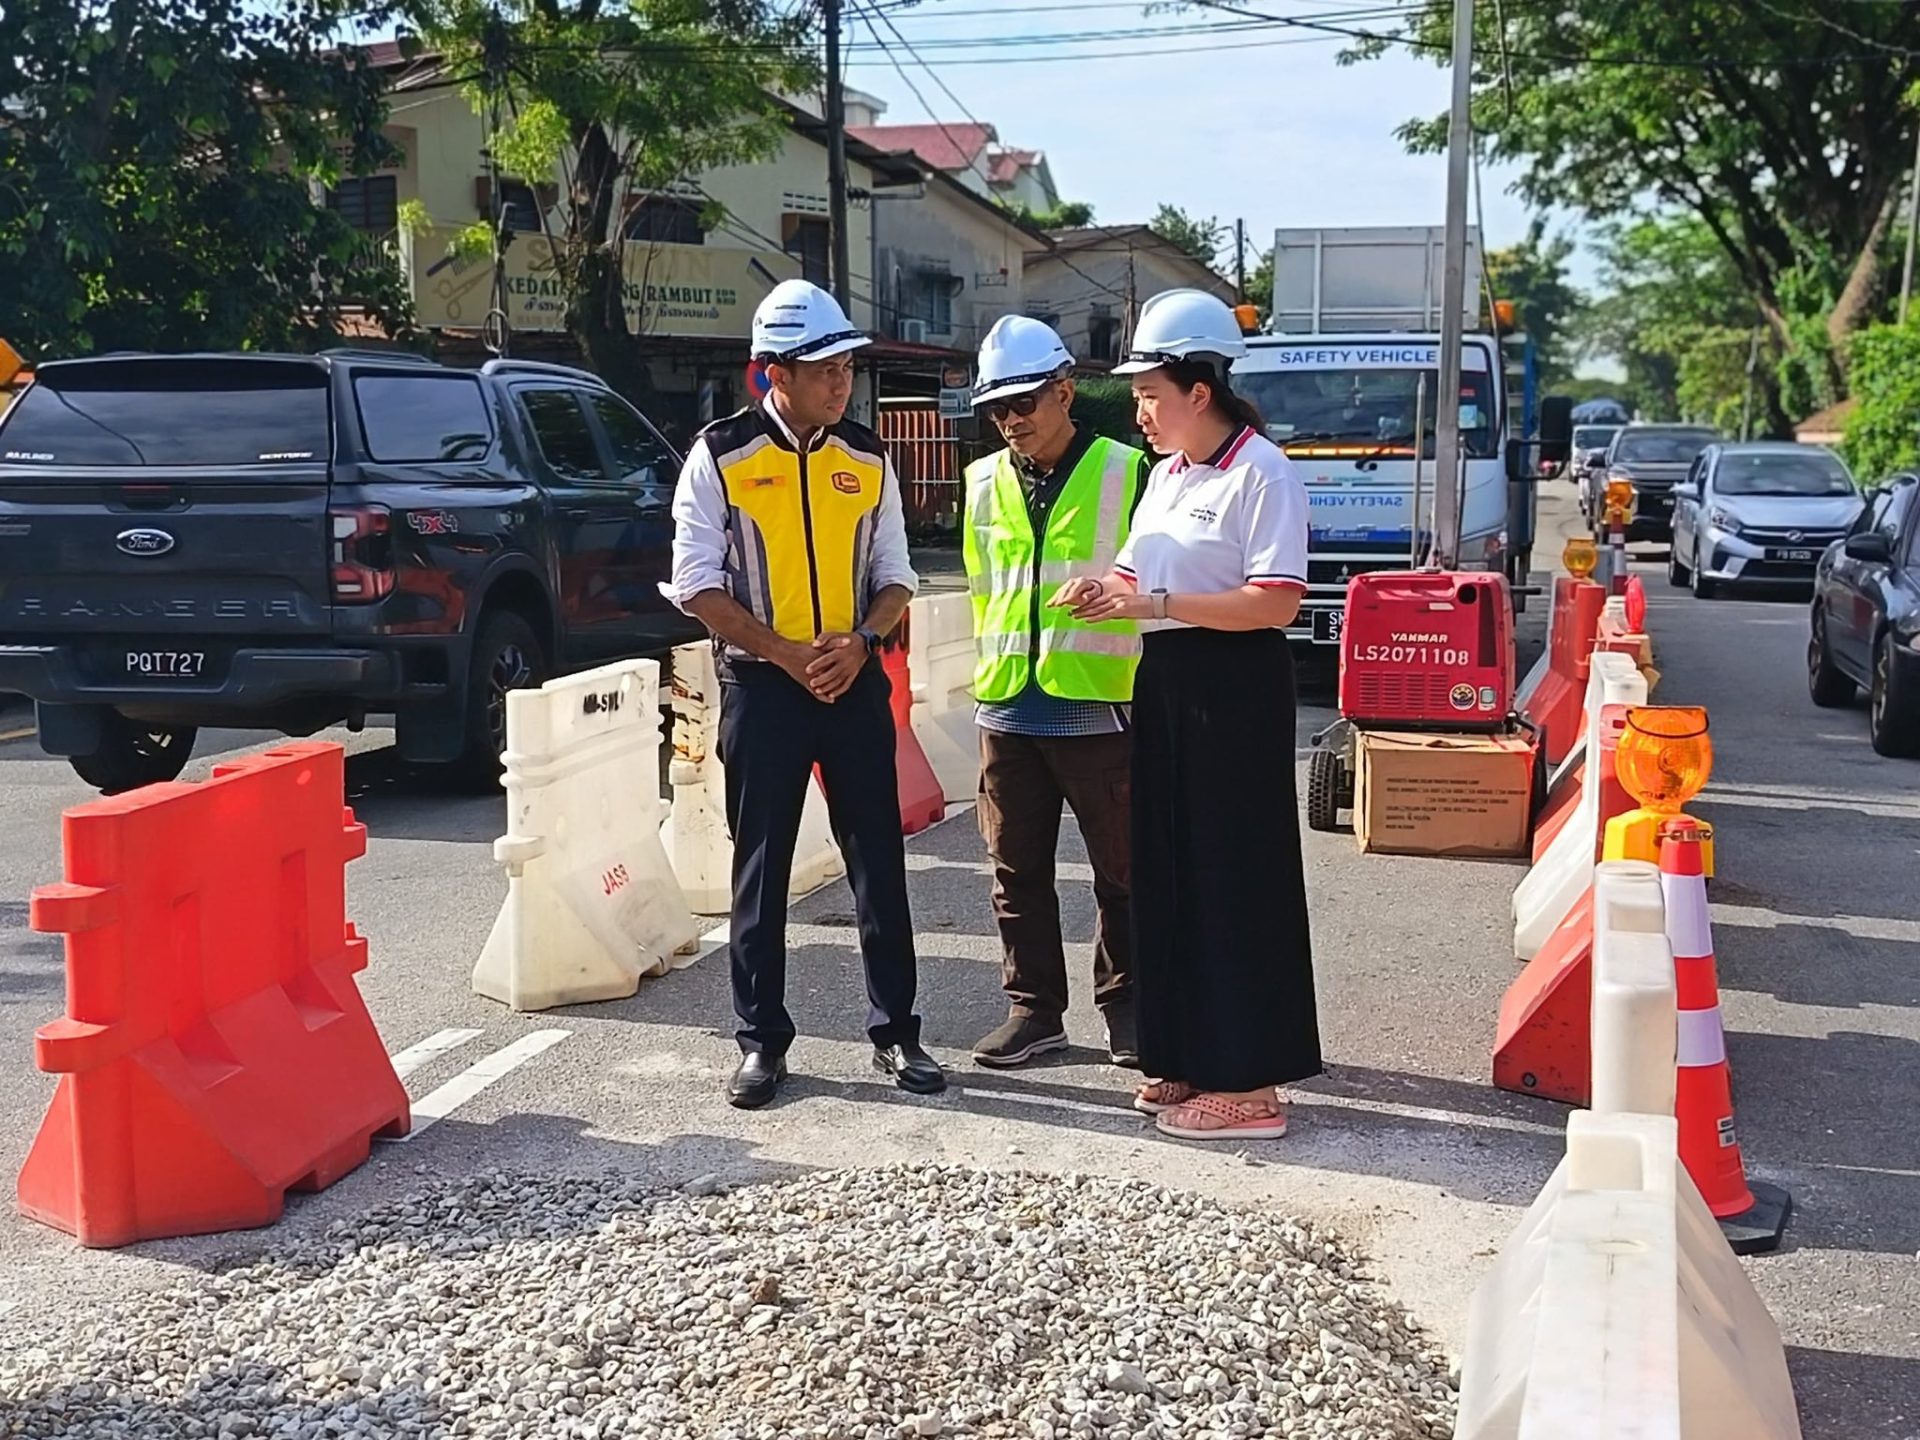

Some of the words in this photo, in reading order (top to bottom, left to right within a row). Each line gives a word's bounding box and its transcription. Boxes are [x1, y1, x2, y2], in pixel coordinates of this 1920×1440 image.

[646, 285, 713, 304] RAMBUT
[1280, 350, 1351, 364] SAFETY
[1356, 350, 1437, 363] VEHICLE
[128, 533, 160, 549] Ford
[18, 599, 297, 617] RANGER
[126, 652, 204, 673] PQT727
[1353, 644, 1469, 666] LS2071108
